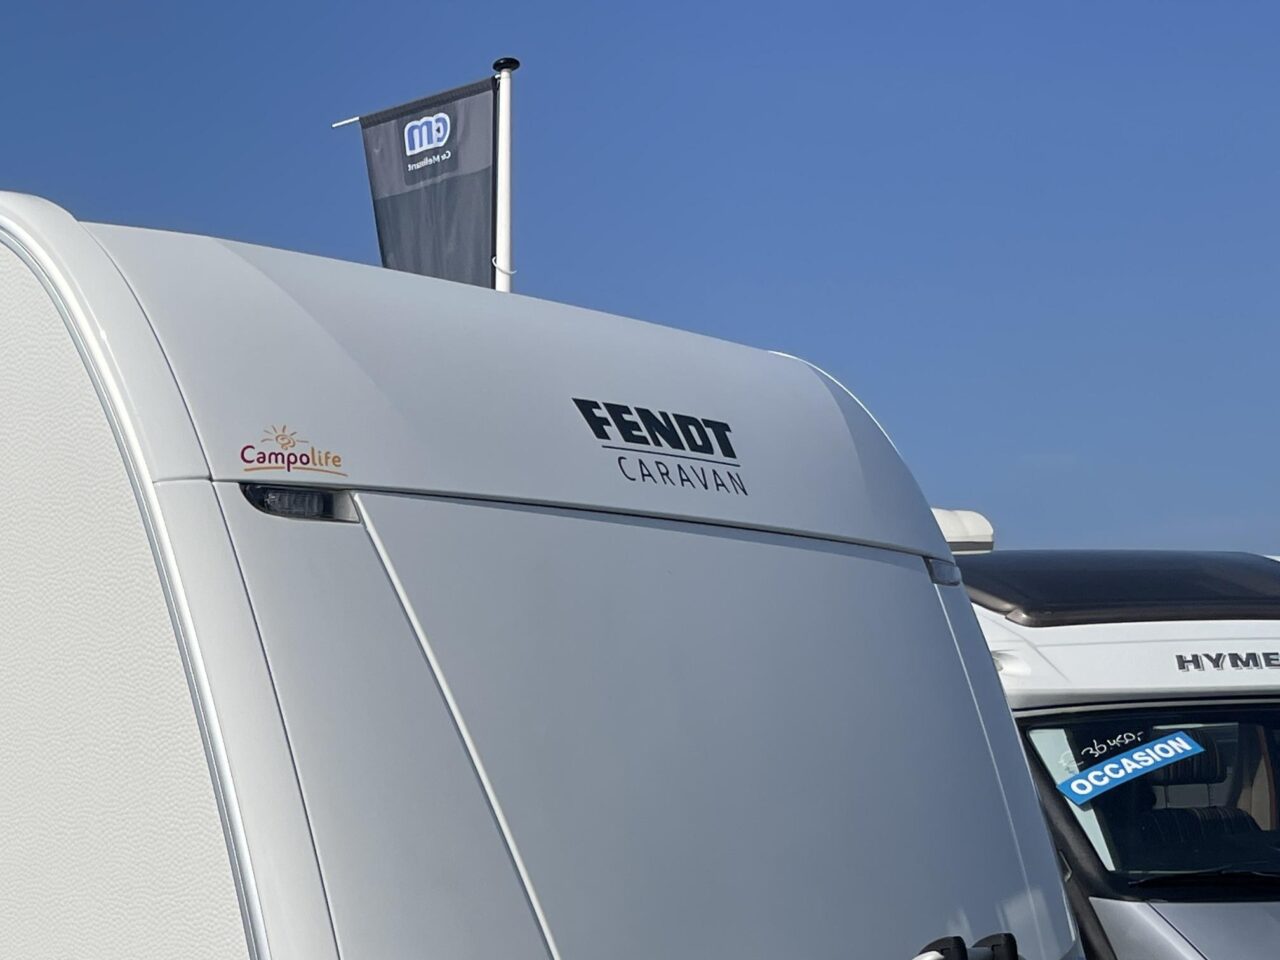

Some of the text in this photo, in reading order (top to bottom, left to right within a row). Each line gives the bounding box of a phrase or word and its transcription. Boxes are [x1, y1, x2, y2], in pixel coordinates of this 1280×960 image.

[572, 397, 738, 459] FENDT
[240, 445, 342, 472] Campolife
[617, 456, 748, 496] CARAVAN
[1070, 737, 1193, 795] OCCASION
